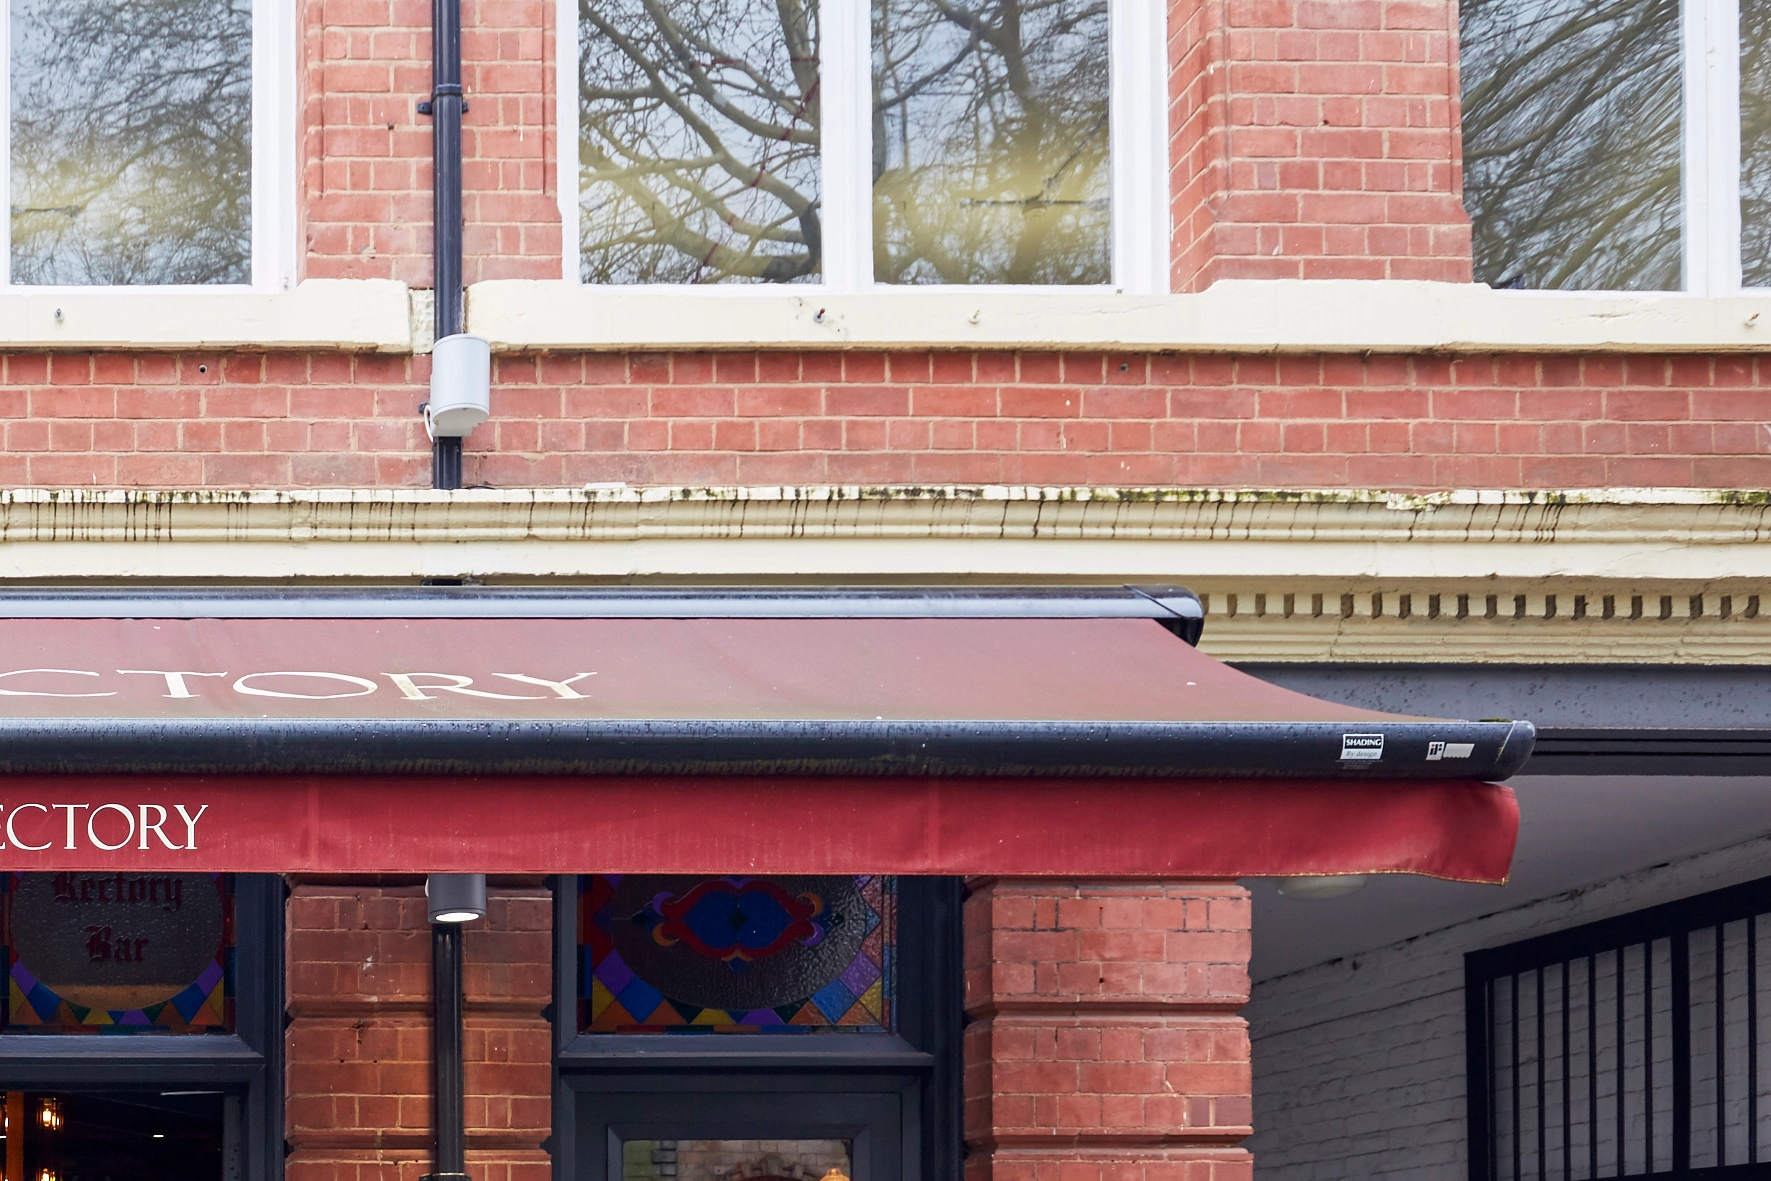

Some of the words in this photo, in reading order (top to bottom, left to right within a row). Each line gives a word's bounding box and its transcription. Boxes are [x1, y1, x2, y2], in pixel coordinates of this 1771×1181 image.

[1346, 738, 1382, 746] SHADING
[51, 871, 182, 912] Rectory
[85, 924, 148, 962] Bar
